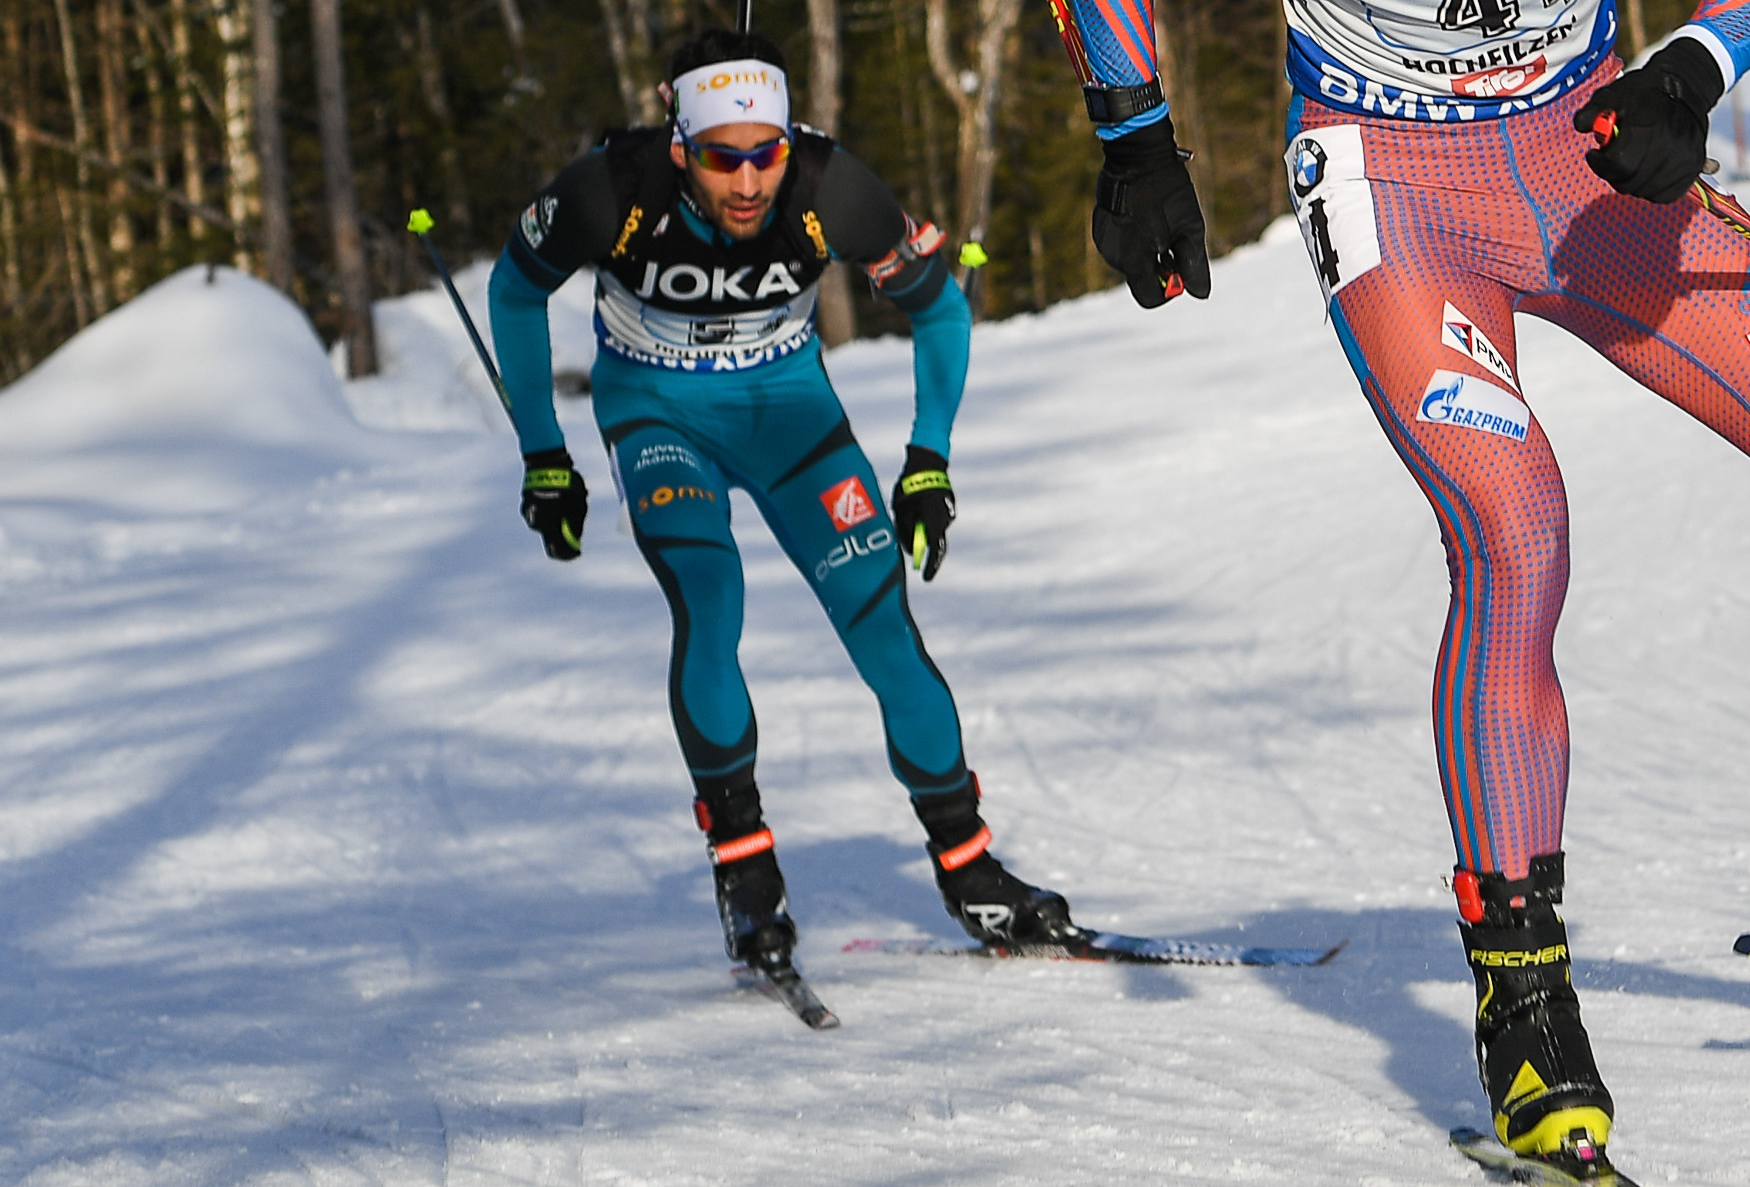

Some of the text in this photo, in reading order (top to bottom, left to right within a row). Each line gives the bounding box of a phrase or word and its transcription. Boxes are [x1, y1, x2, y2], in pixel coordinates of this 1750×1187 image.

[1319, 61, 1476, 122] BMW
[635, 260, 801, 302] JOKA
[1452, 407, 1526, 439] GAZPROM
[814, 528, 893, 583] odlo
[1470, 943, 1568, 968] FISCHER
